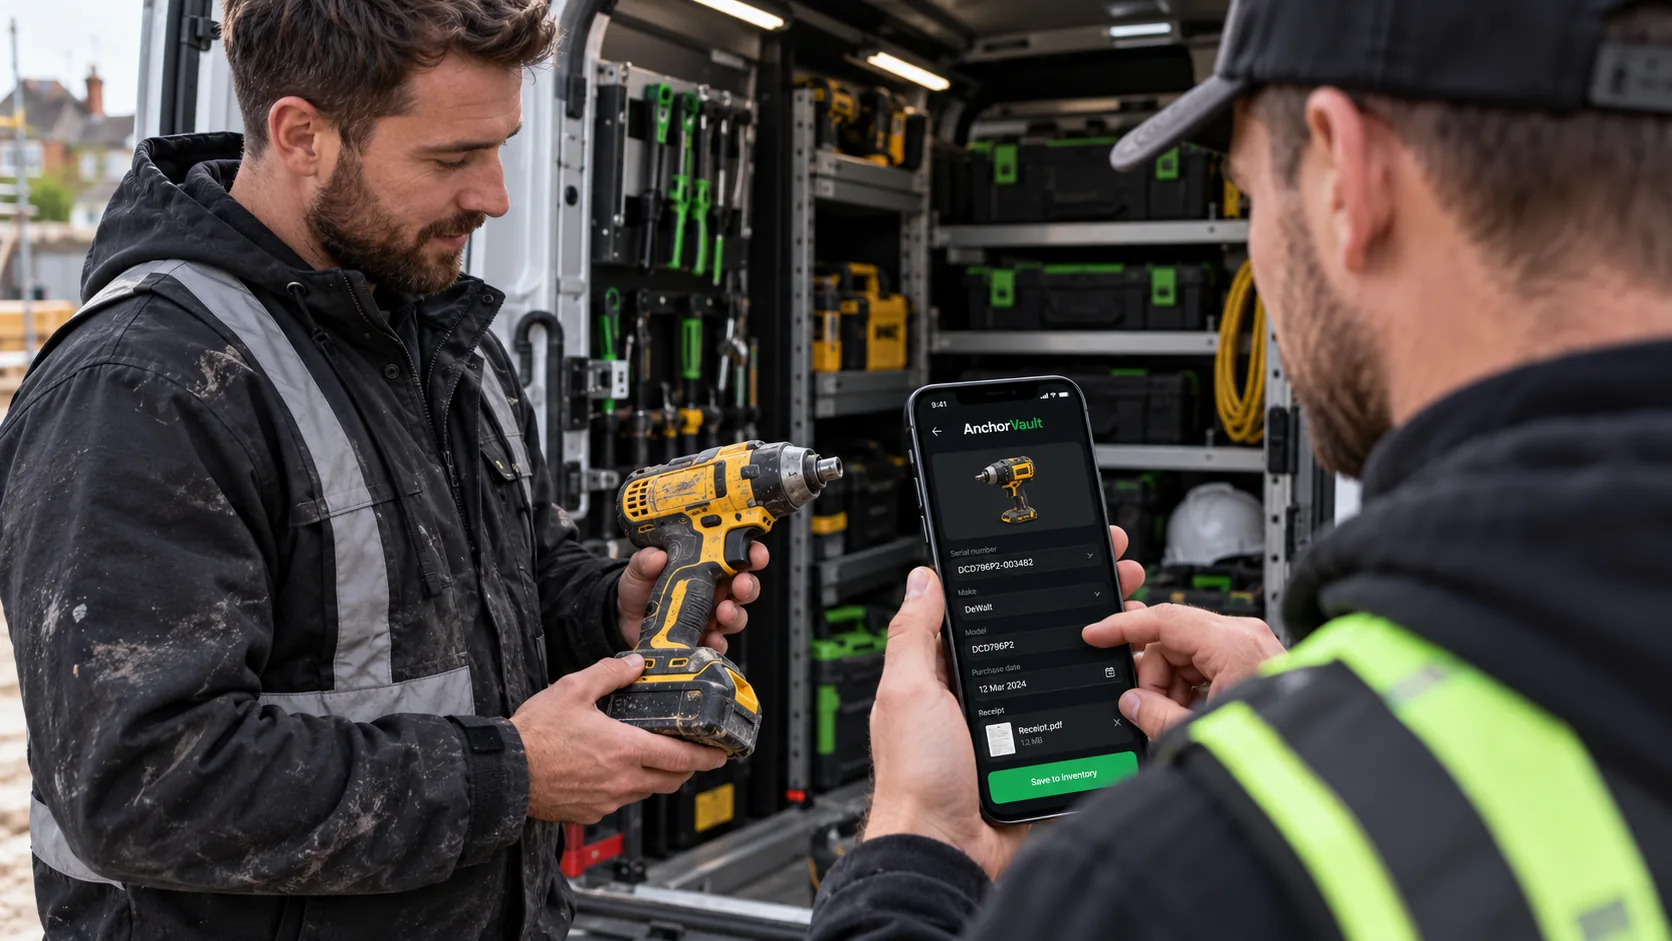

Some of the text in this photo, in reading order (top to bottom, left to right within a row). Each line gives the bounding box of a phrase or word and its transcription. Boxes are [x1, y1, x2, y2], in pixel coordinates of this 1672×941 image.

[931, 400, 947, 409] 9:41
[963, 417, 1044, 435] AnchorVault
[950, 546, 997, 557] Serial number
[957, 588, 977, 596] Make
[964, 603, 993, 614] DeWalt
[964, 627, 987, 637] Model
[971, 663, 1021, 676] Purchase date
[978, 680, 1027, 694] 12 Mar 2024
[978, 707, 1005, 717] Receipt
[1018, 720, 1063, 735] Receipt.pdf
[1031, 770, 1098, 786] Save to inventory
